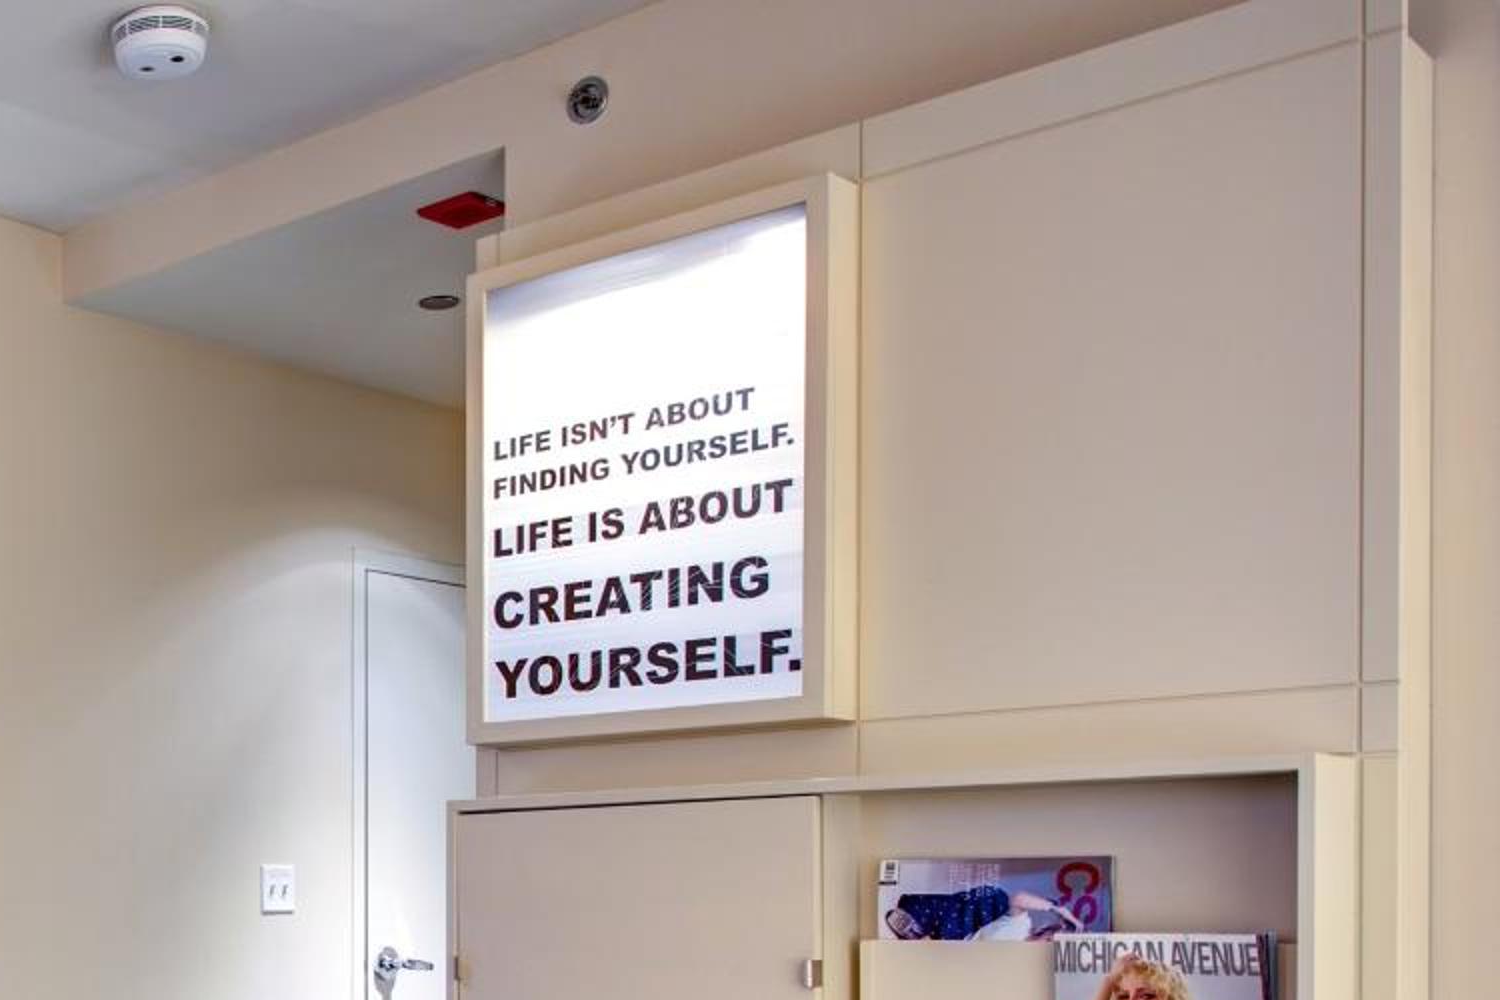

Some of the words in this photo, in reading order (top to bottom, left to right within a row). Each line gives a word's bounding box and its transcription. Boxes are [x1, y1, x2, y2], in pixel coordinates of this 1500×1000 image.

[494, 430, 551, 461] LIFE
[645, 387, 755, 431] ABOUT
[494, 458, 610, 500] FINDING
[621, 423, 795, 475] YOURSELF.
[494, 516, 573, 558] LIFE
[588, 507, 625, 543] IS
[638, 478, 793, 535] ABOUT
[494, 556, 770, 630] CREATING
[495, 628, 803, 699] YOURSELF.
[1171, 940, 1261, 977] AVENUE
